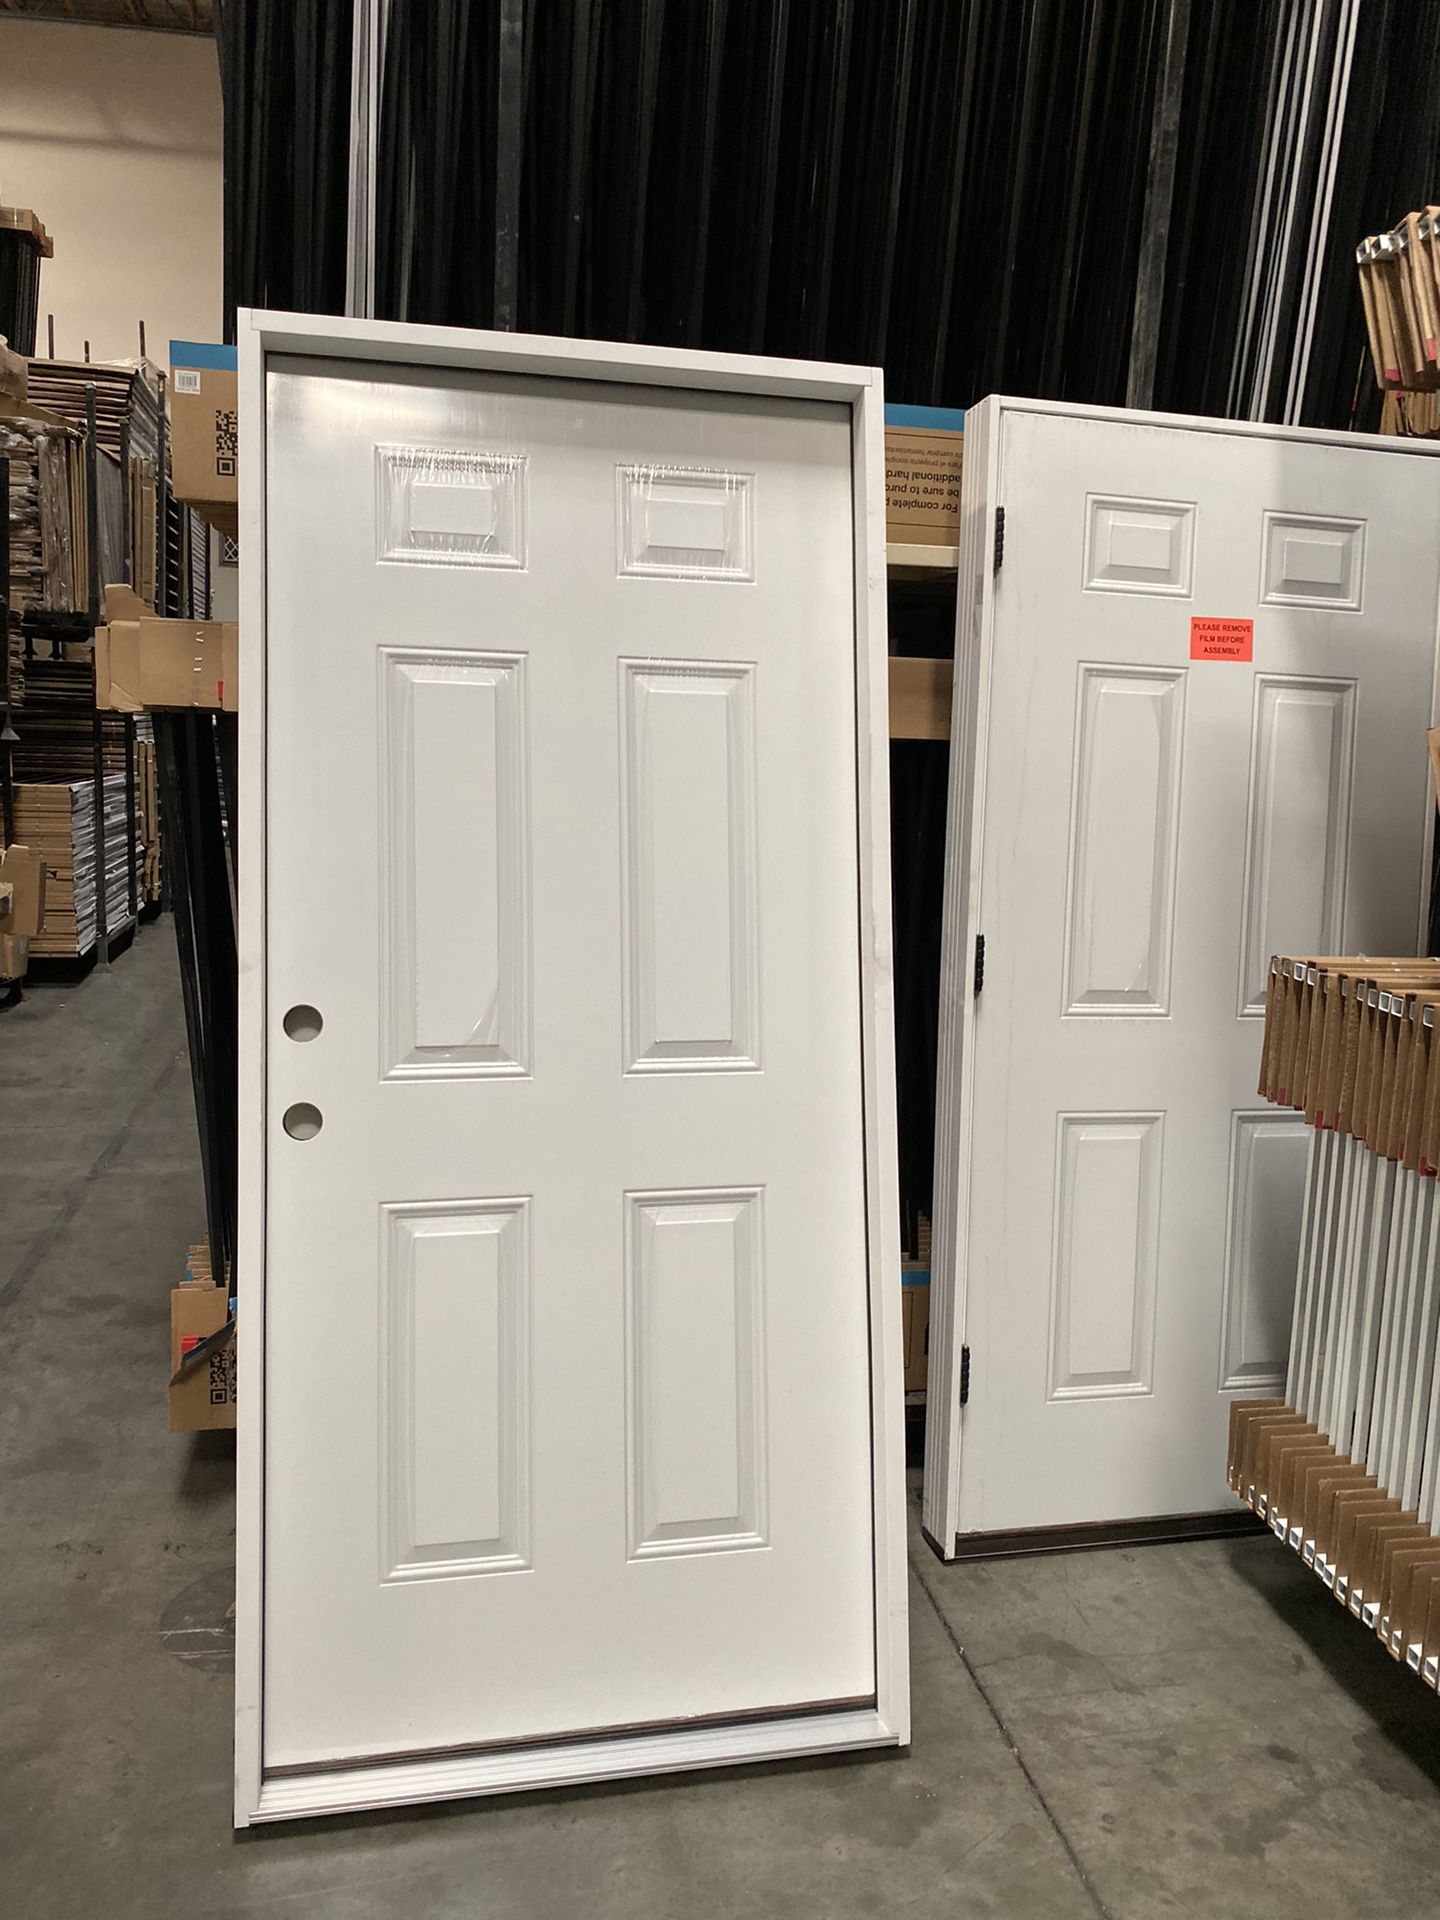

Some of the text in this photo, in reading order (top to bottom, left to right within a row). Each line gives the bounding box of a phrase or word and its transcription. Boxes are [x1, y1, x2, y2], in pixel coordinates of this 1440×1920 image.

[886, 470, 961, 483] additional hard
[910, 486, 919, 495] to
[922, 486, 944, 495] sure
[947, 488, 959, 498] be
[892, 499, 939, 510] complete
[941, 503, 958, 513] For
[1193, 623, 1251, 633] PLEASE REMOVE
[1199, 634, 1245, 644] FILM BEFORE
[1203, 646, 1241, 655] ASSEMBLY
